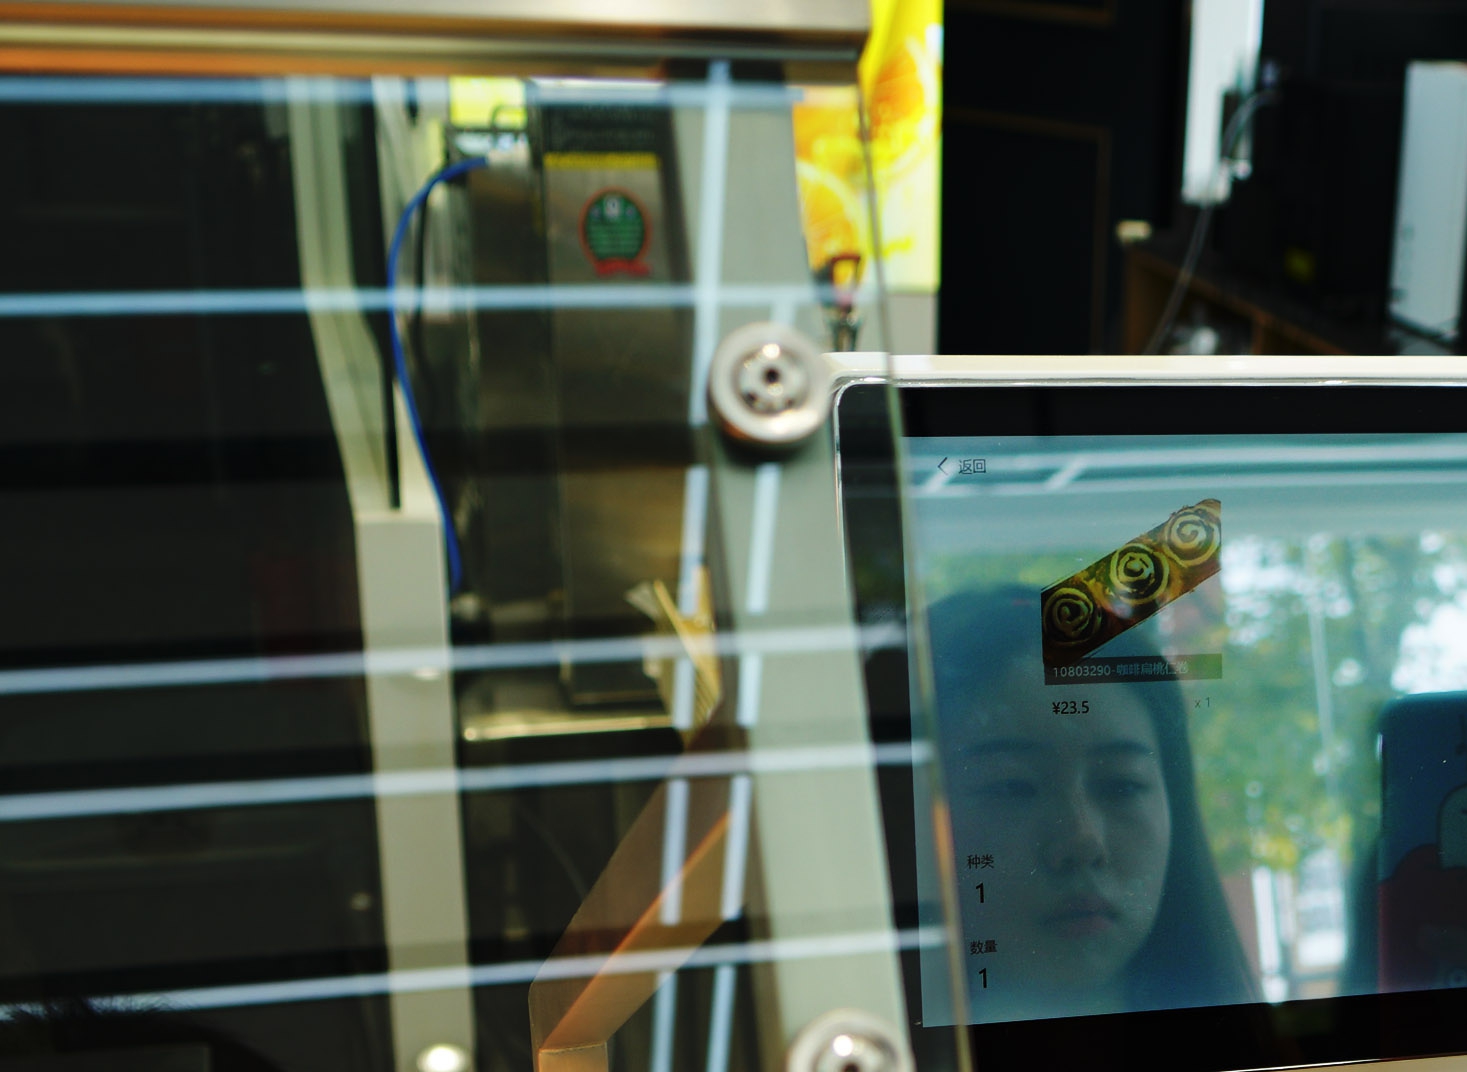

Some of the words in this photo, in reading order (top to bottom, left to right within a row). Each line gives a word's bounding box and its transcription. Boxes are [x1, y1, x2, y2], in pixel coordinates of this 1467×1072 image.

[959, 458, 986, 475] 返回
[1052, 700, 1090, 715] ¥23.5
[967, 854, 994, 869] 种类
[975, 882, 985, 904] 1
[970, 940, 998, 955] 数量
[978, 967, 988, 989] 1
